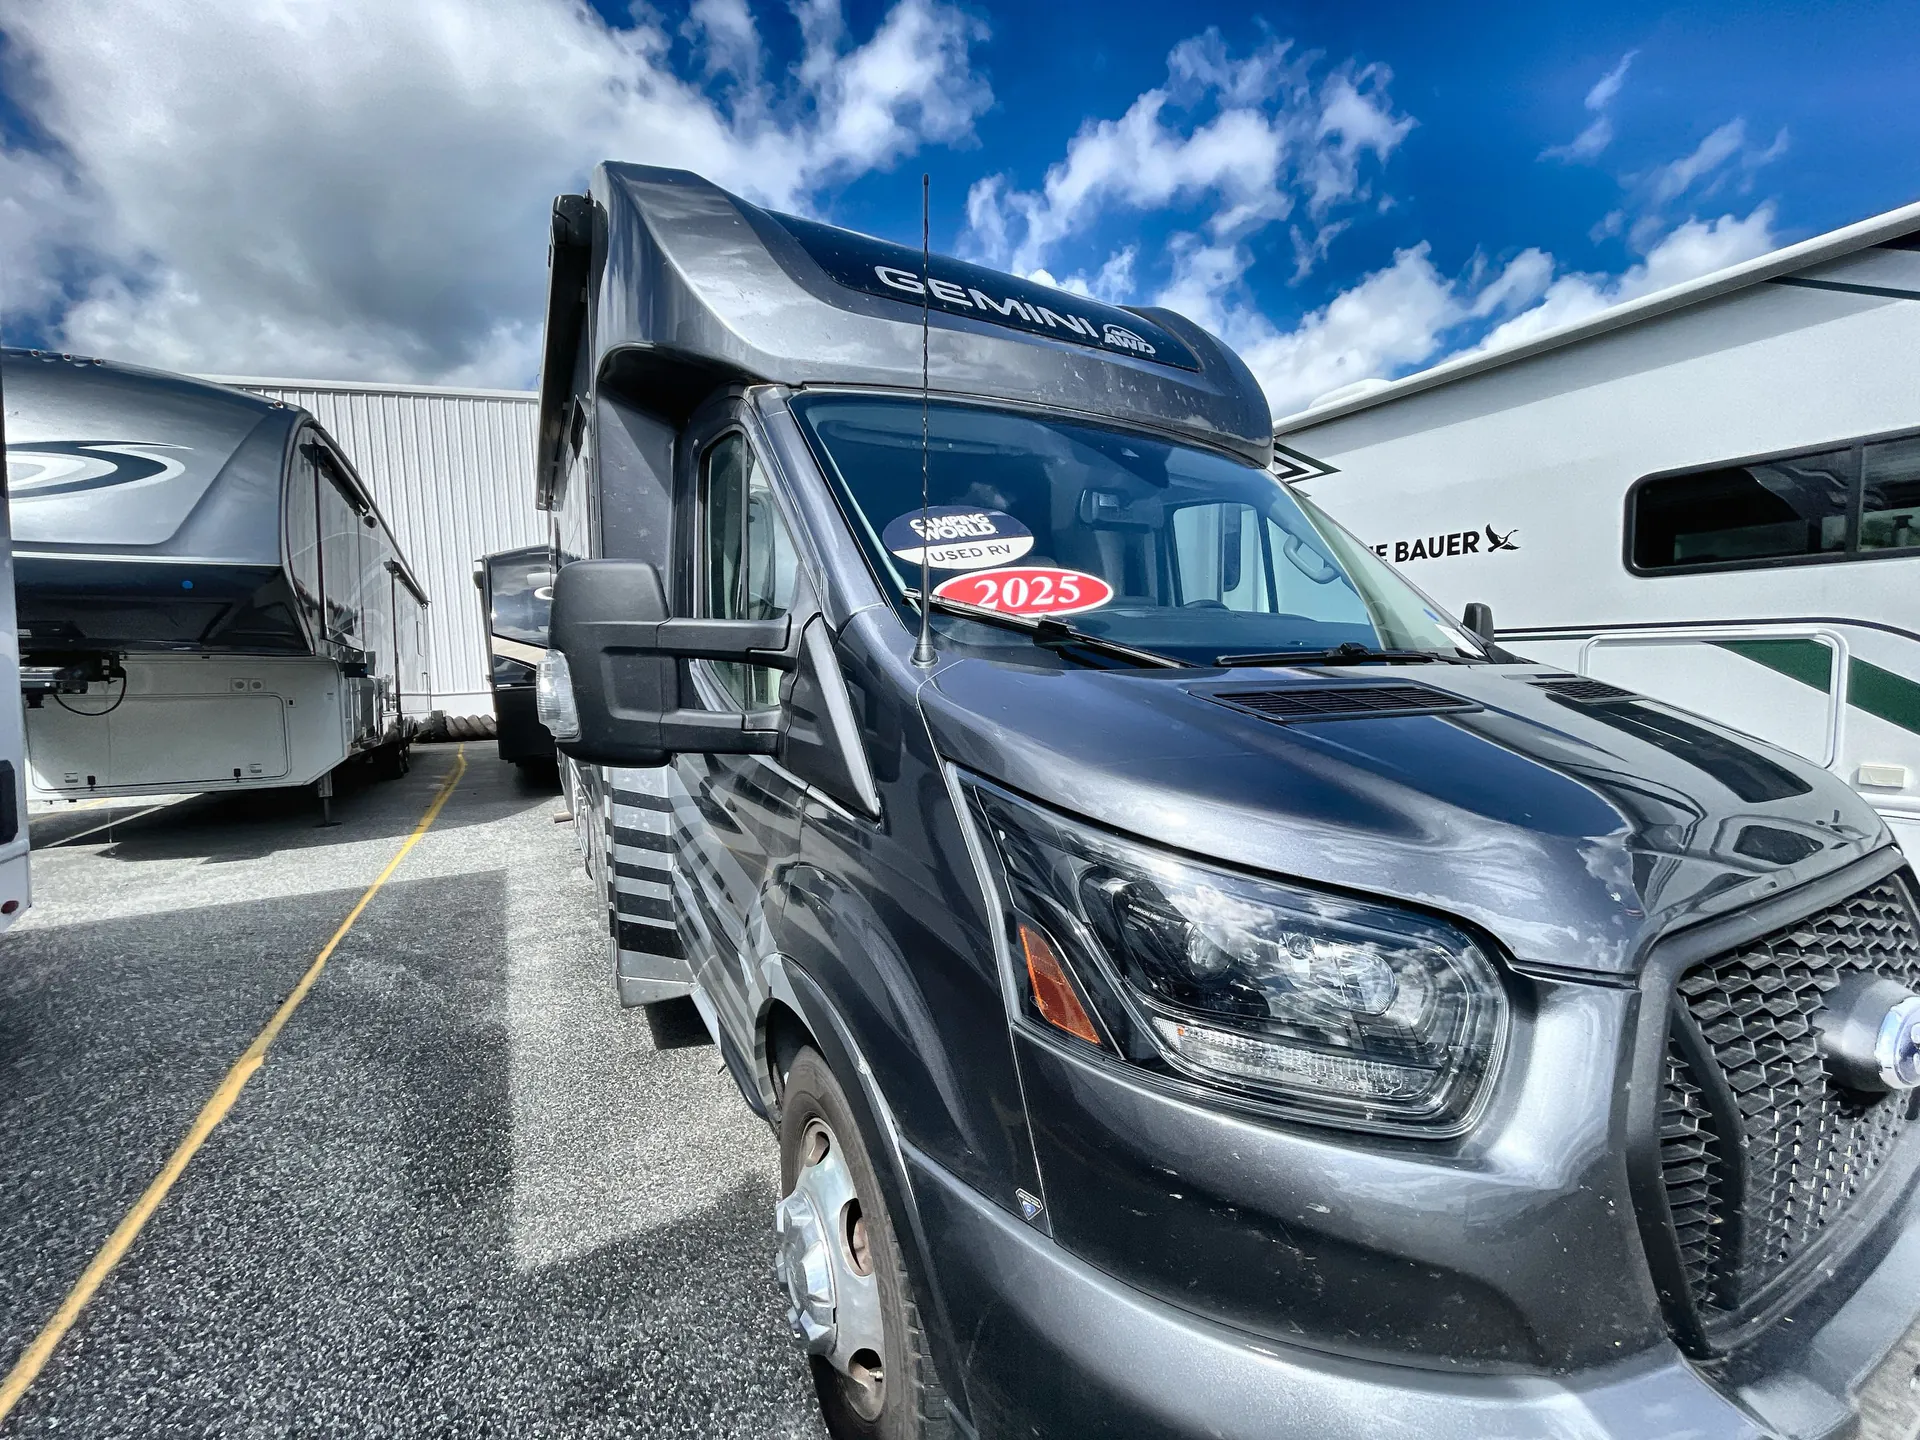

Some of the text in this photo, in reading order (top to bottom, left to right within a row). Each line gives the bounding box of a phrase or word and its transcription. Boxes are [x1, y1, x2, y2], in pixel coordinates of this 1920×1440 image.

[873, 264, 1156, 354] GEMINI AWD
[909, 513, 990, 531] CAMPING
[930, 544, 1011, 562] USED RV
[1394, 530, 1480, 563] BAUER
[973, 575, 1081, 610] 2025
